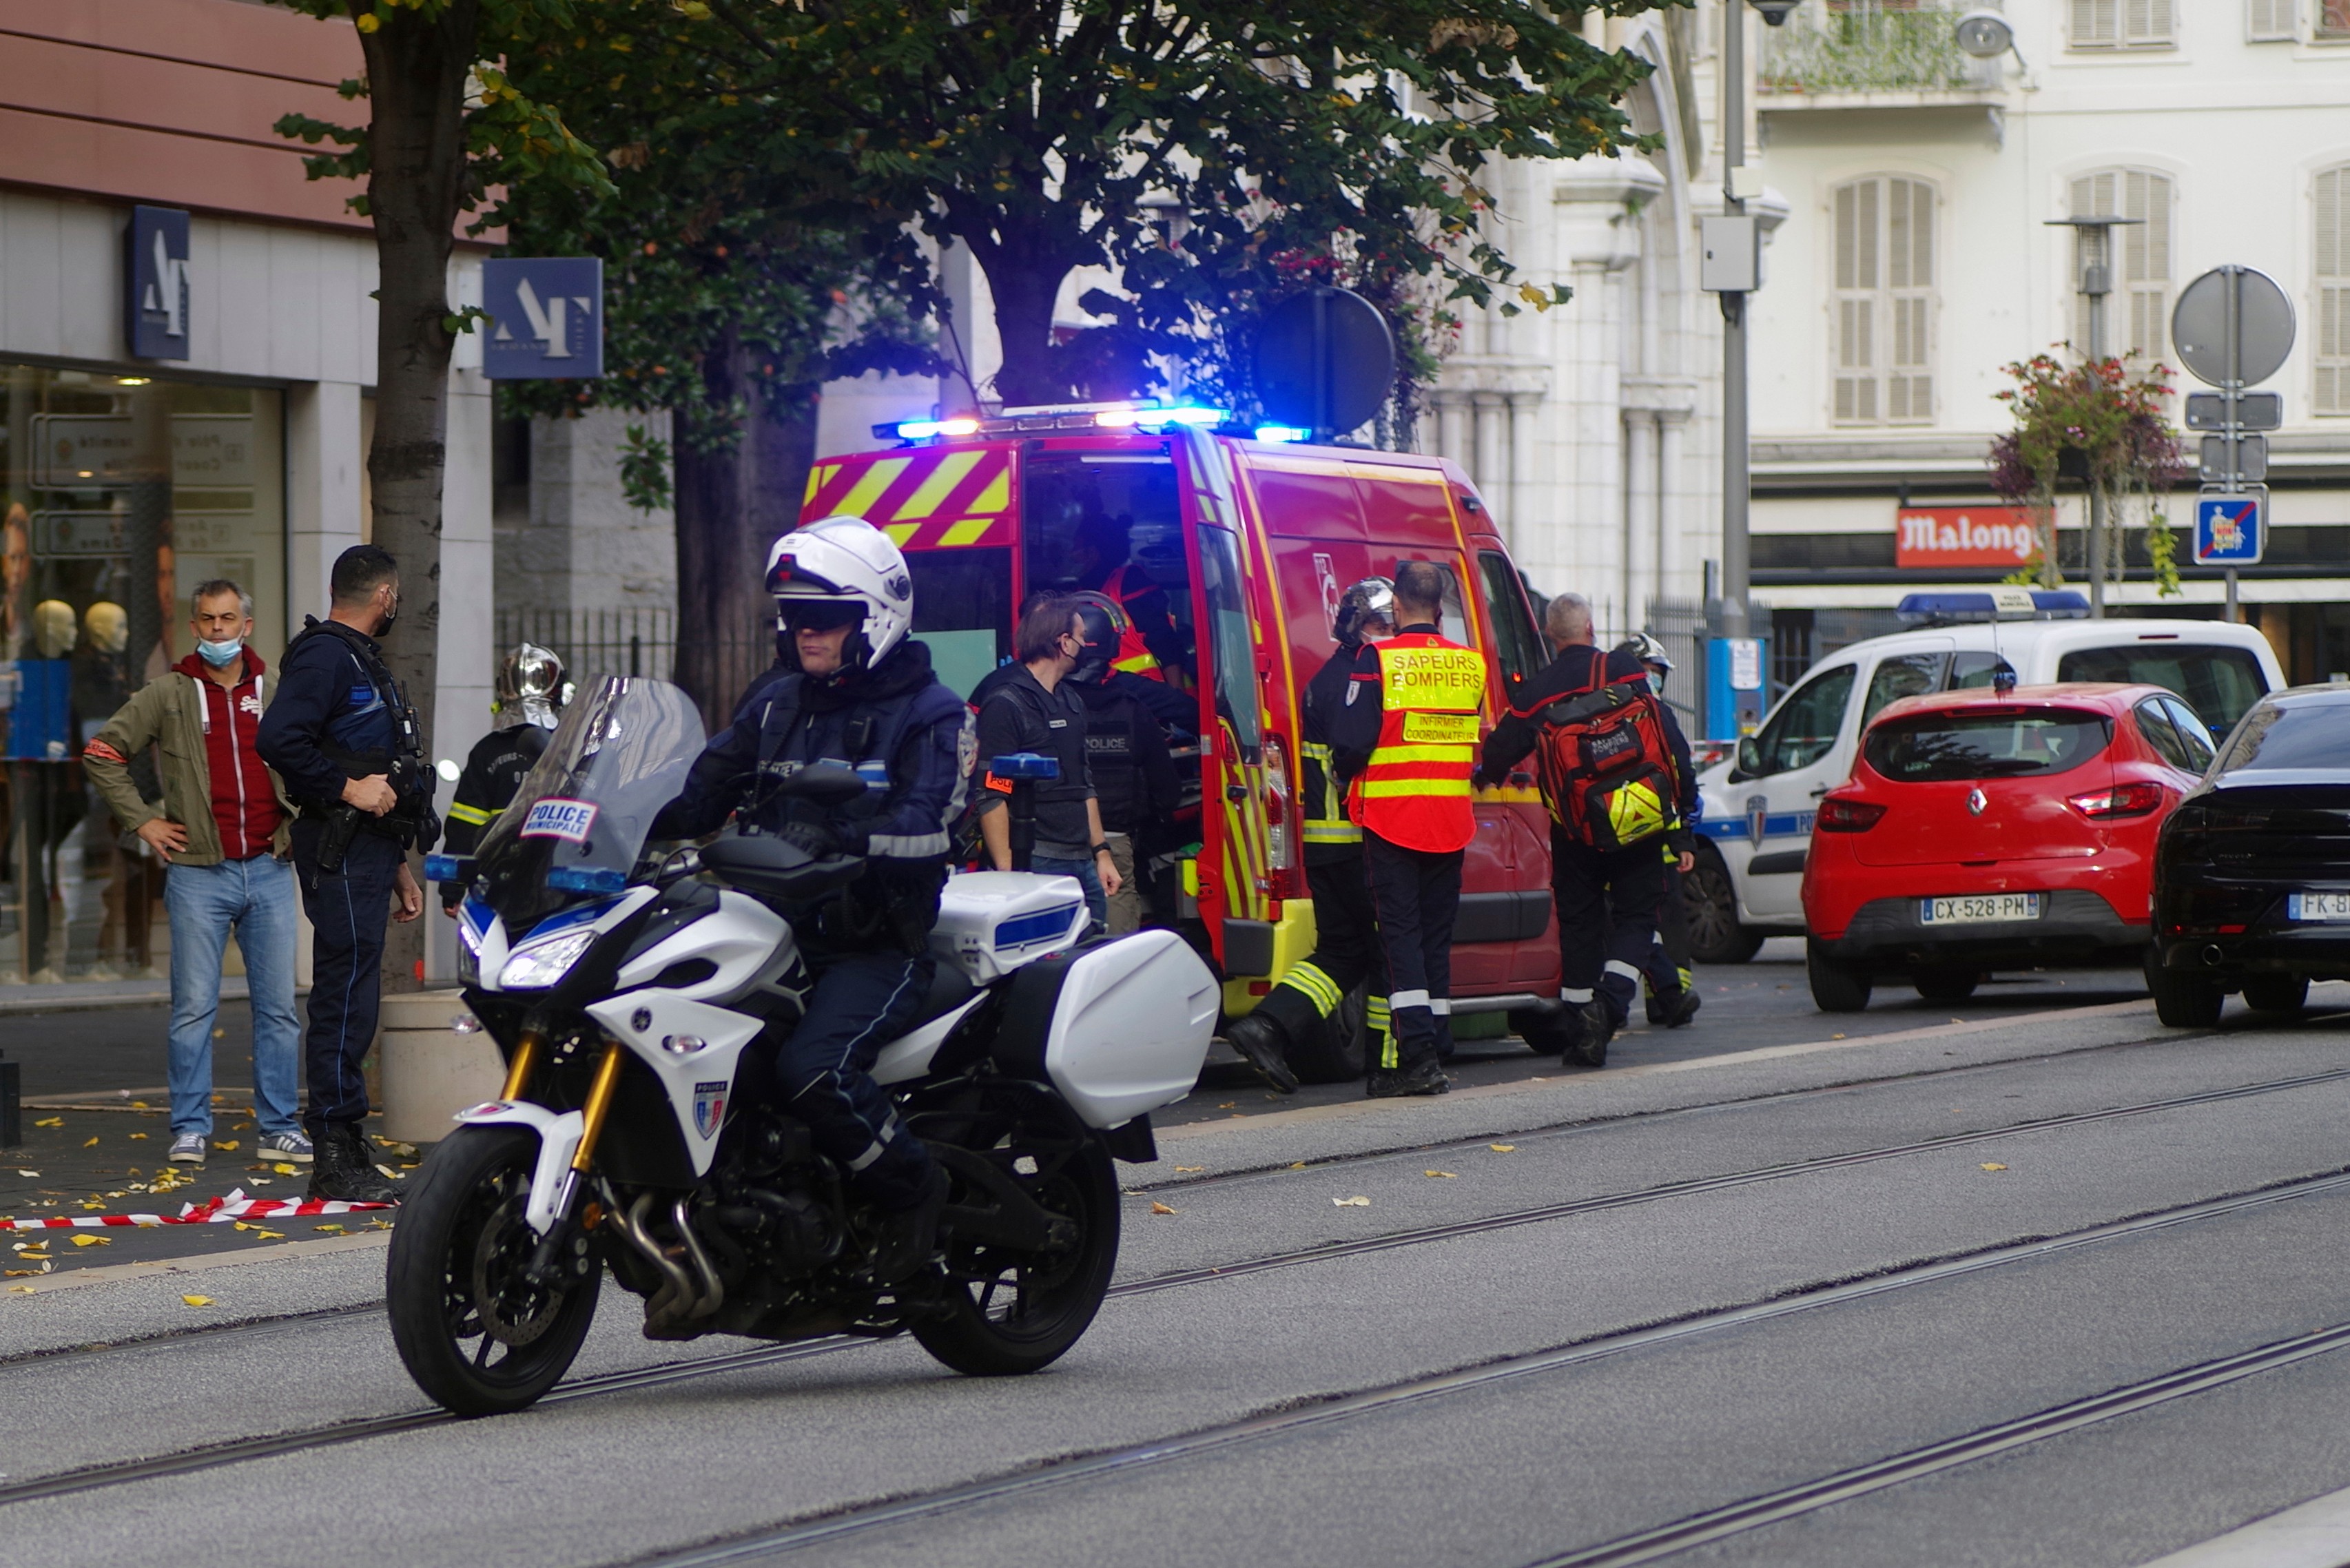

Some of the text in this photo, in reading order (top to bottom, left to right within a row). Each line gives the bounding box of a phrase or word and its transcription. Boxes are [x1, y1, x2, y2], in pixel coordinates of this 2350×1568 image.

[1394, 655, 1478, 671] SAPEURS
[1392, 672, 1481, 690] POMPIERS
[1419, 715, 1465, 728] INFIRMIER
[1405, 728, 1476, 741] COORDINATEUR
[530, 805, 590, 825] POLICE
[525, 821, 585, 835] MUNICIPALE
[2305, 895, 2350, 914] FK-8
